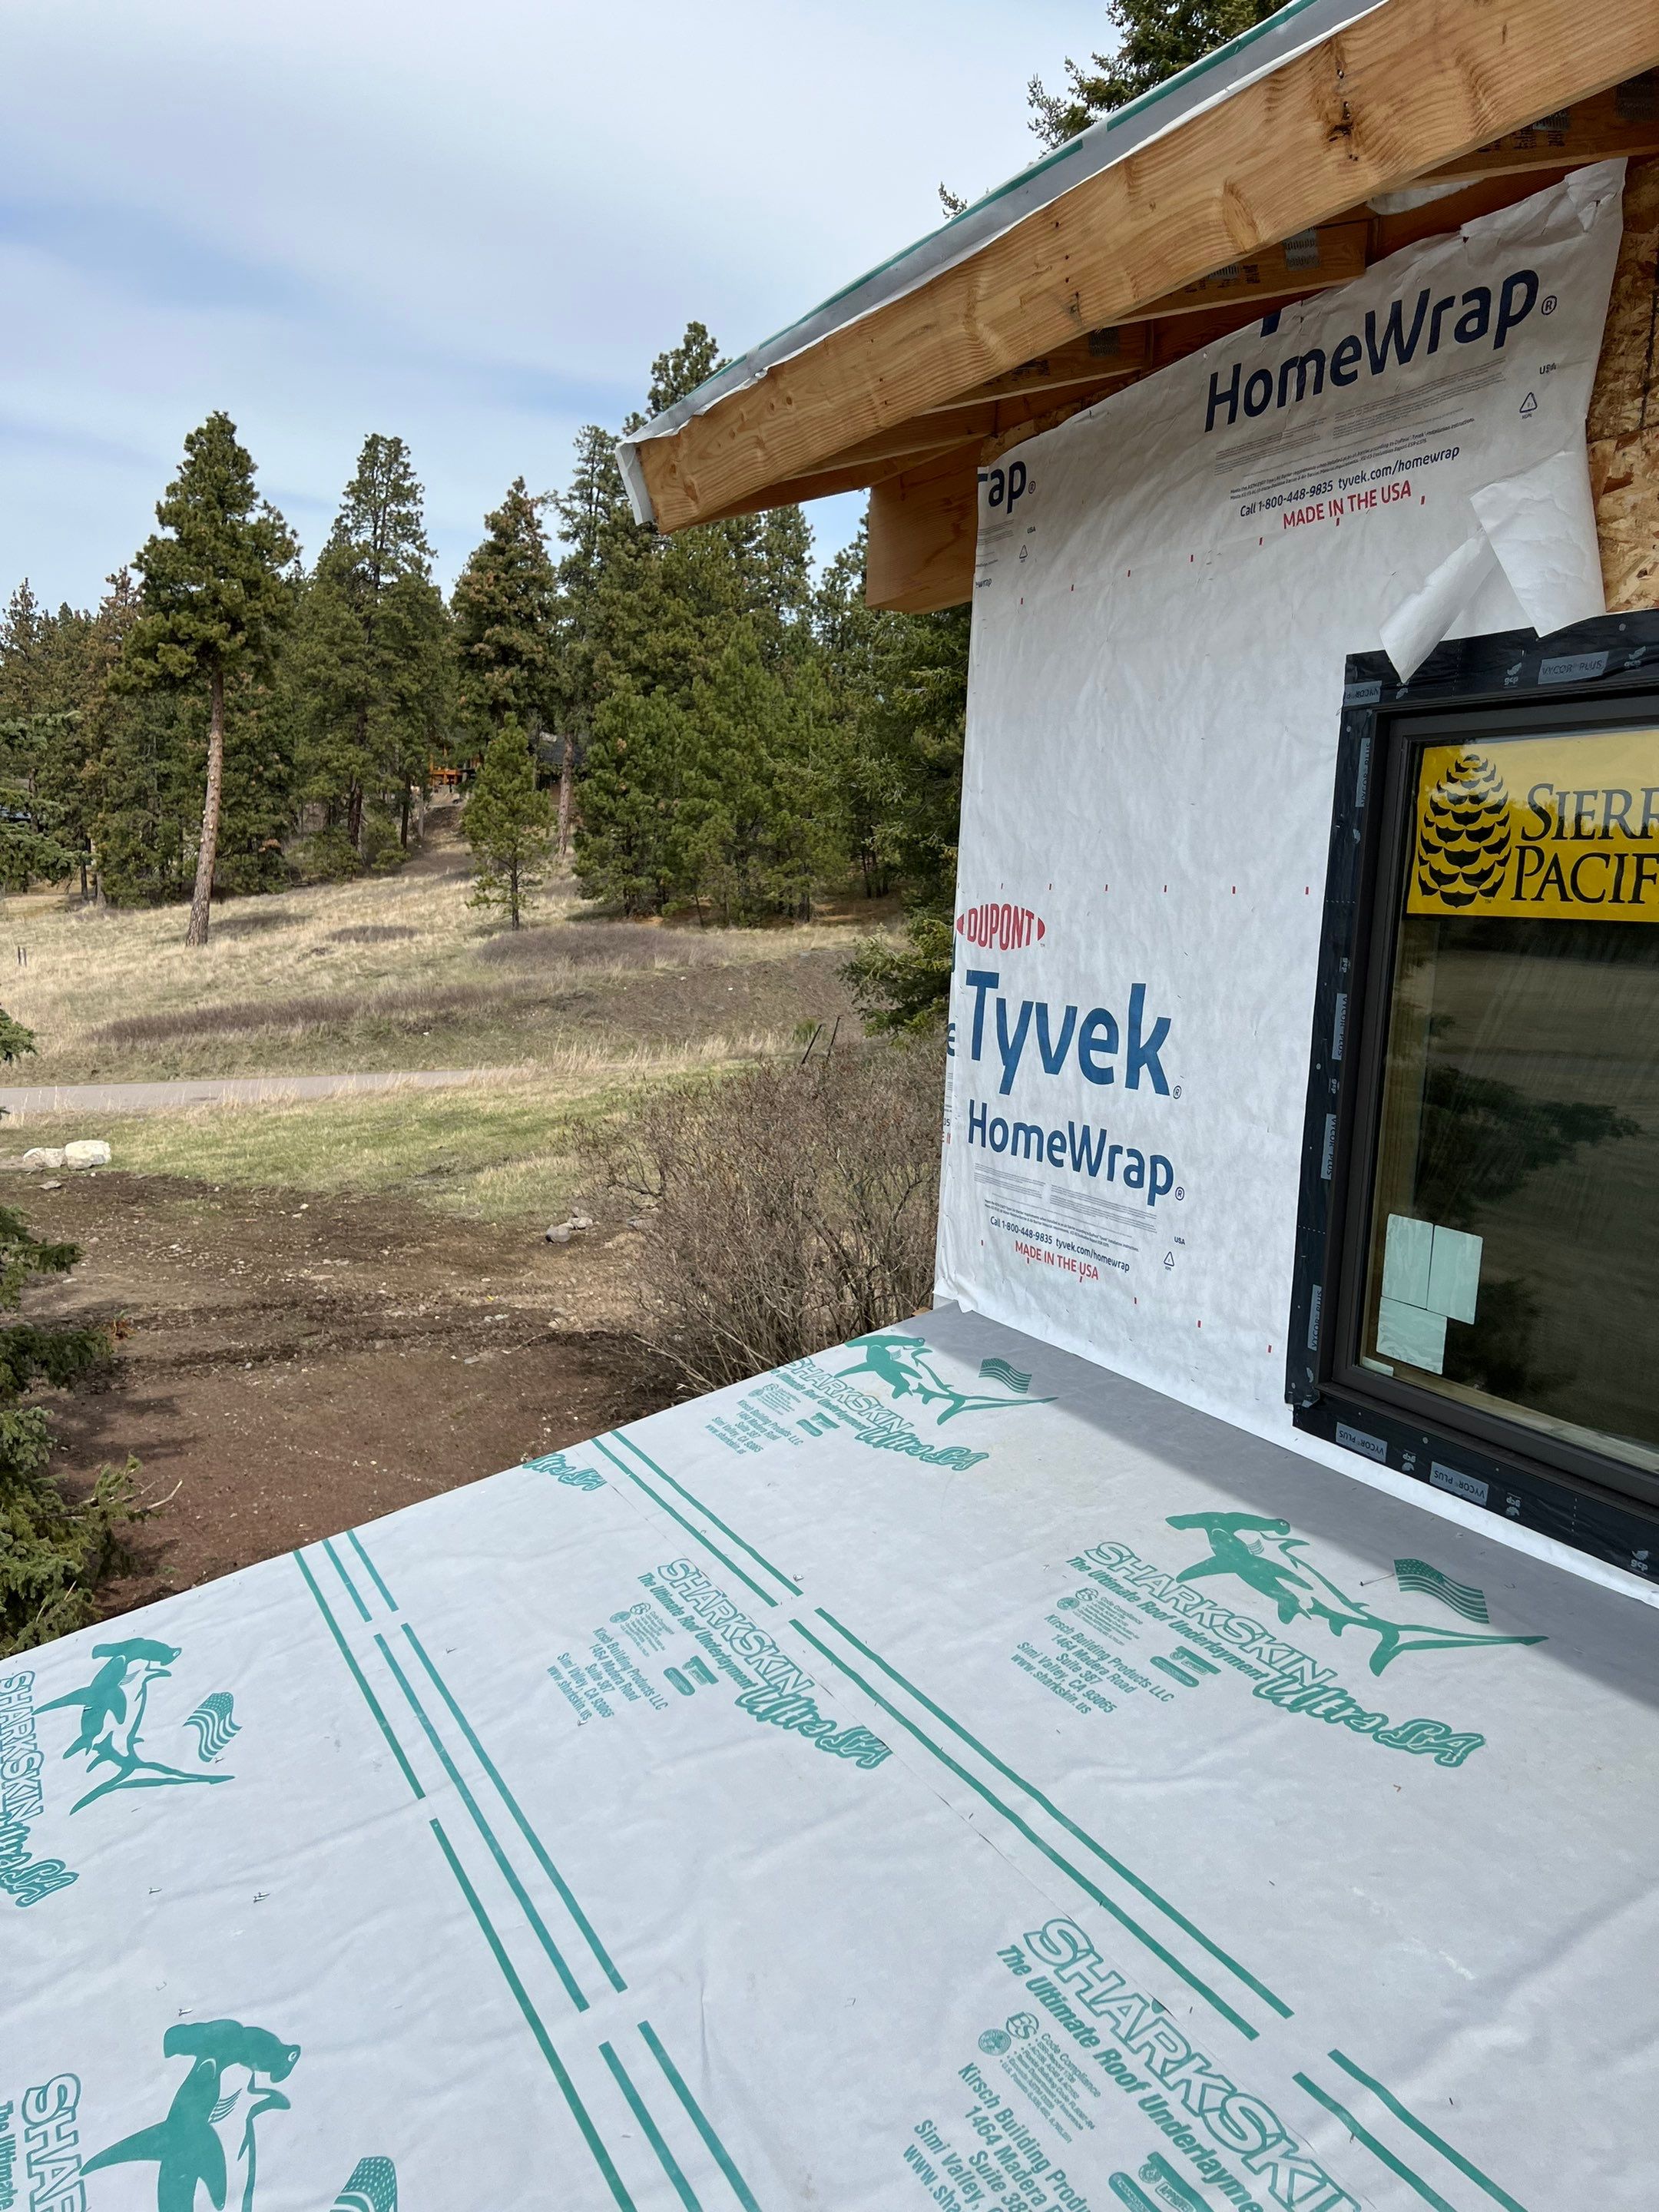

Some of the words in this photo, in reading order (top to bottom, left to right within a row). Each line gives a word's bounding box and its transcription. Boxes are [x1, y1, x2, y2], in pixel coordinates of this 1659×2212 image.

[1240, 503, 1256, 517] Call
[1259, 480, 1333, 512] 1-800-448-9835
[1339, 447, 1459, 491] tyvek.com/homewrap
[1283, 503, 1324, 529] MADE
[1329, 498, 1343, 518] IN
[1347, 489, 1377, 512] THE
[1382, 480, 1412, 504] USA
[1541, 664, 1573, 676] VYCOR
[1578, 659, 1602, 671] PLUS
[967, 903, 1035, 950] DUPONT
[991, 1216, 1001, 1227] Call
[1002, 1220, 1052, 1244] 1-800-448-9835
[1055, 1238, 1130, 1273] tyvek.com/homewrap
[1015, 1240, 1041, 1261] MADE
[1044, 1250, 1054, 1265] IN
[1057, 1254, 1077, 1272] THE
[1079, 1261, 1098, 1280] USA
[1174, 1236, 1185, 1246] USA
[802, 1389, 827, 1400] Roof
[788, 1435, 803, 1445] LLC
[1339, 1429, 1356, 1442] PLUS
[1359, 1440, 1384, 1455] VYCOR
[1434, 1469, 1453, 1484] PLUS
[1458, 1481, 1486, 1499] VYCOR
[1631, 1559, 1648, 1571] gcp
[637, 1572, 656, 1587] The
[650, 1584, 685, 1617] Ultimate
[677, 1615, 707, 1633] Roof
[695, 1631, 759, 1690] Underlayment
[657, 1558, 815, 1696] SHARKSKIN
[1066, 1557, 1091, 1572] The
[1088, 1570, 1141, 1603] Ultimate
[1137, 1601, 1177, 1621] Roof
[1168, 1620, 1270, 1681] Underlayment
[1084, 1541, 1338, 1686] SHARKSKIN
[557, 1652, 576, 1669] Simi
[584, 1663, 604, 1681] Suite
[597, 1680, 615, 1693] 387
[588, 1643, 609, 1661] 1464
[601, 1659, 625, 1685] Madera
[619, 1682, 641, 1701] Road
[593, 1627, 615, 1644] Kirsch
[607, 1642, 634, 1672] Building
[628, 1668, 656, 1697] Products
[649, 1694, 668, 1710] LLC
[1010, 1654, 1091, 1714] www.sharkskin.us
[1017, 1642, 1042, 1660] Simi
[1068, 1677, 1088, 1692] CA
[1082, 1689, 1118, 1714] 93065
[1045, 1614, 1074, 1634] Kirsch
[1071, 1632, 1111, 1661] Building
[1108, 1657, 1151, 1687] Products
[1149, 1684, 1175, 1703] LLC
[1051, 1634, 1077, 1651] 1464
[1072, 1648, 1109, 1676] Madera
[1107, 1673, 1138, 1694] Road
[1056, 1653, 1082, 1673] Suite
[1079, 1671, 1103, 1686] 387
[547, 1665, 592, 1721] www.sharkskin.us
[584, 1687, 599, 1700] CA
[591, 1697, 614, 1718] 93065
[1253, 1674, 1389, 1733] Ultra
[997, 1945, 1032, 1977] The
[1025, 1974, 1100, 2049] Ultimate
[1094, 2048, 1153, 2094] Roof
[1040, 2032, 1063, 2055] Code
[1058, 2051, 1103, 2098] Compliance
[958, 2062, 1000, 2109] Kirsch
[994, 2108, 1052, 2174] Building
[914, 2120, 951, 2154] Simi
[941, 2152, 985, 2210] Valley,
[965, 2105, 1003, 2146] 1464
[994, 2144, 1048, 2207] Madera
[969, 2151, 1006, 2193] Suite
[1001, 2193, 1033, 2212] 38
